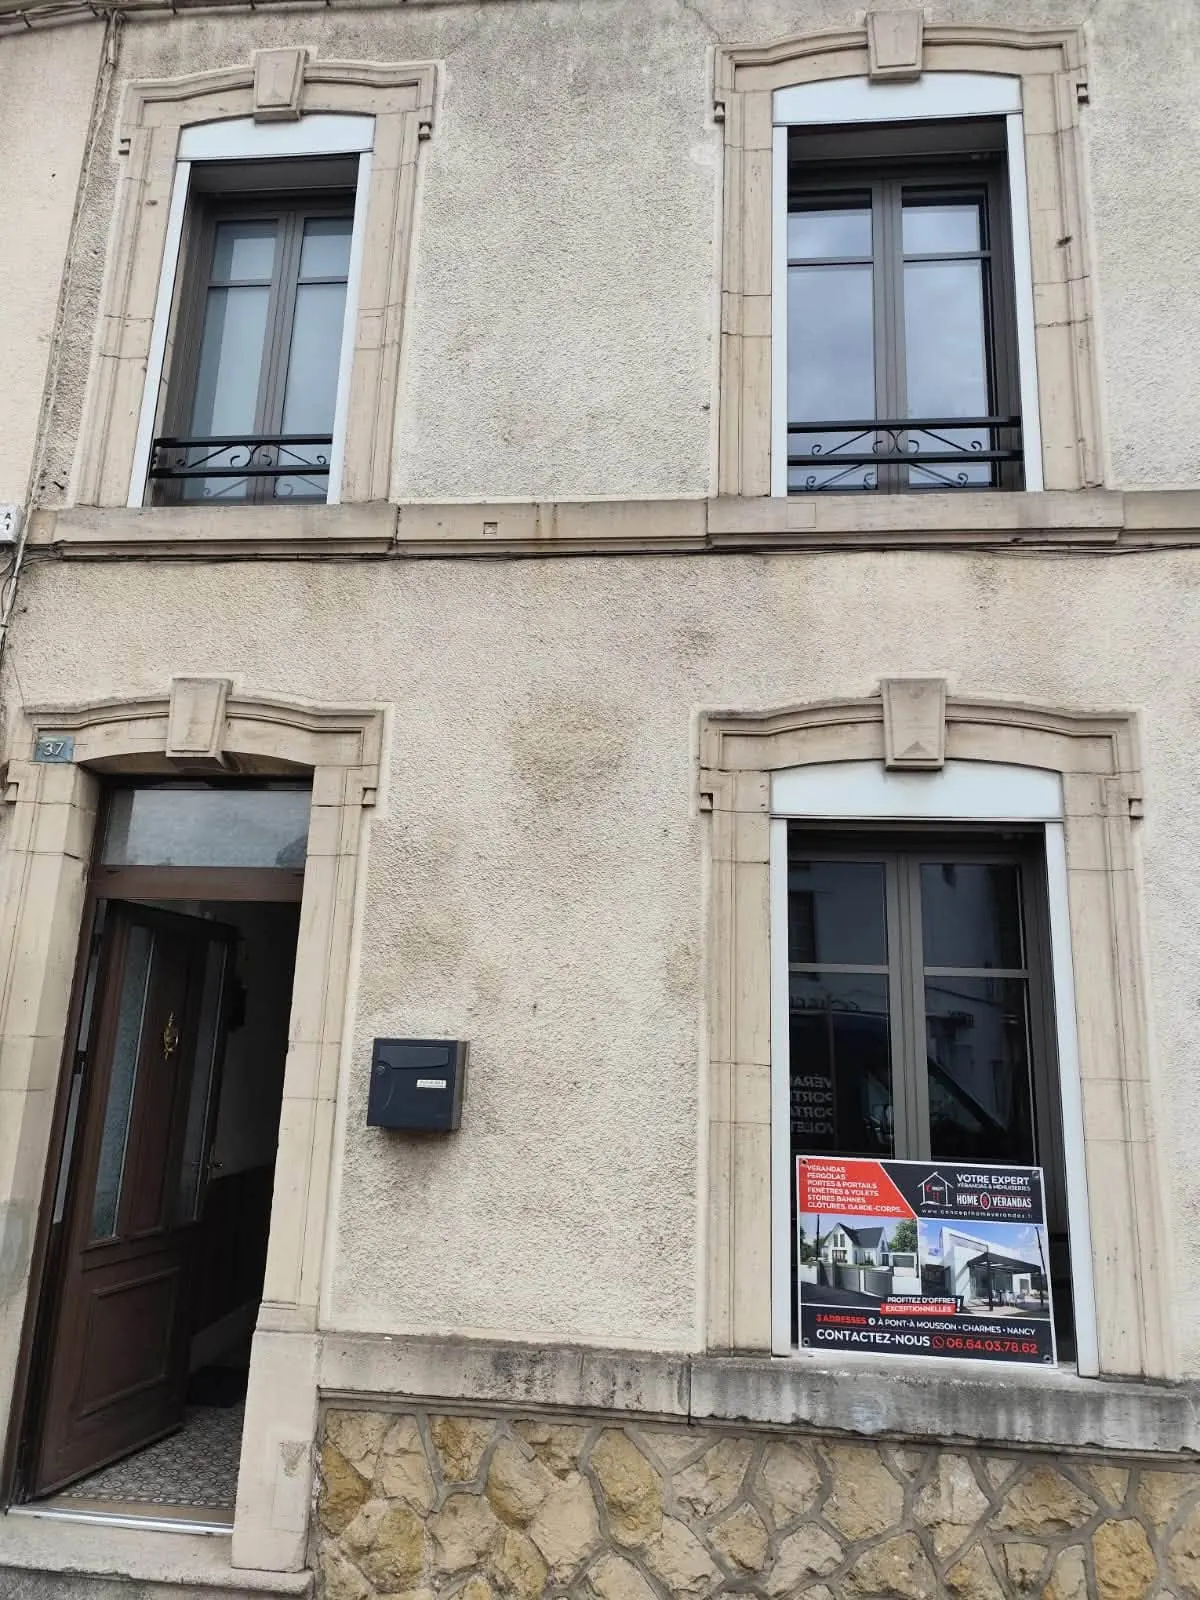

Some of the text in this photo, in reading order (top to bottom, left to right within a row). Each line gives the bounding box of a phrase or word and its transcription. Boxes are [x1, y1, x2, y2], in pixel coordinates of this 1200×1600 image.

[44, 742, 65, 756] 37
[807, 1172, 846, 1181] PERGOLAS
[956, 1173, 1029, 1185] VOTRE EXPERT
[807, 1180, 835, 1188] PORTES
[843, 1181, 878, 1190] PORTAILS
[851, 1189, 879, 1197] VOLETS
[807, 1195, 866, 1204] STORES BANNES
[956, 1194, 978, 1206] HOME
[888, 1296, 920, 1304] PROFITEZ
[886, 1305, 952, 1313] EXCEPTIONNELLES
[823, 1314, 867, 1325] ADRESSES
[917, 1321, 957, 1330] MOUSSON
[962, 1324, 1001, 1333] CHARMES
[1007, 1327, 1036, 1335] NANCY
[816, 1329, 1038, 1354] CONTACTEZ-NOUS 06.64.03.78.62
